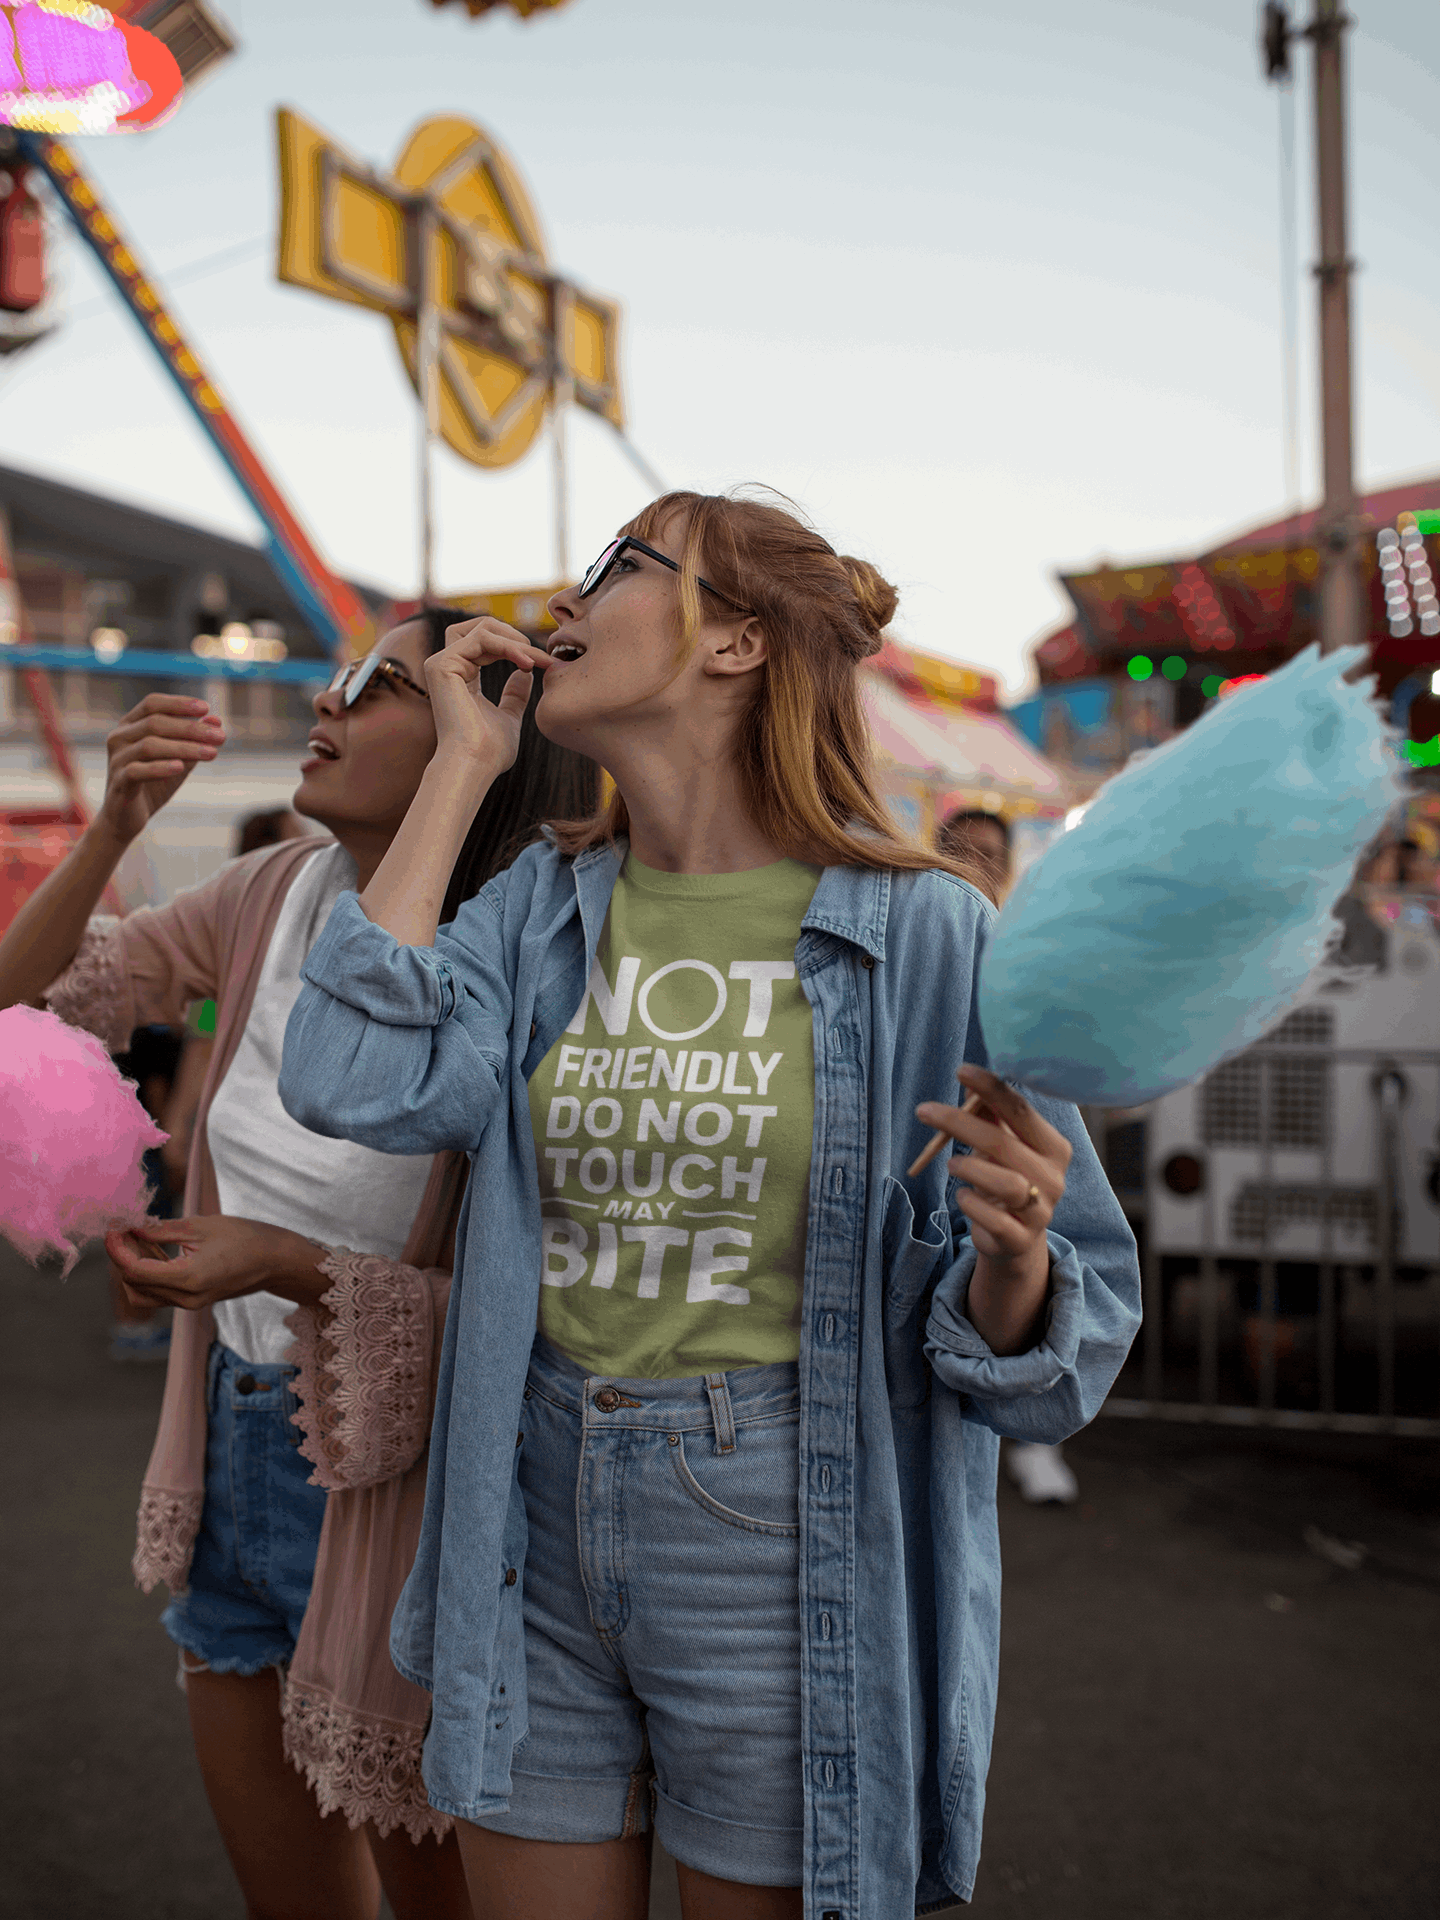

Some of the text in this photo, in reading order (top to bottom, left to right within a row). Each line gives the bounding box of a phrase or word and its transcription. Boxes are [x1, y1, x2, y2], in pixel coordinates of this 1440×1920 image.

[565, 956, 795, 1041] NOT
[554, 1044, 783, 1096] FRIENDLY
[546, 1095, 778, 1148] DO NOT
[544, 1147, 767, 1203] TOUCH
[603, 1200, 676, 1221] MAY
[541, 1217, 752, 1305] BITE
